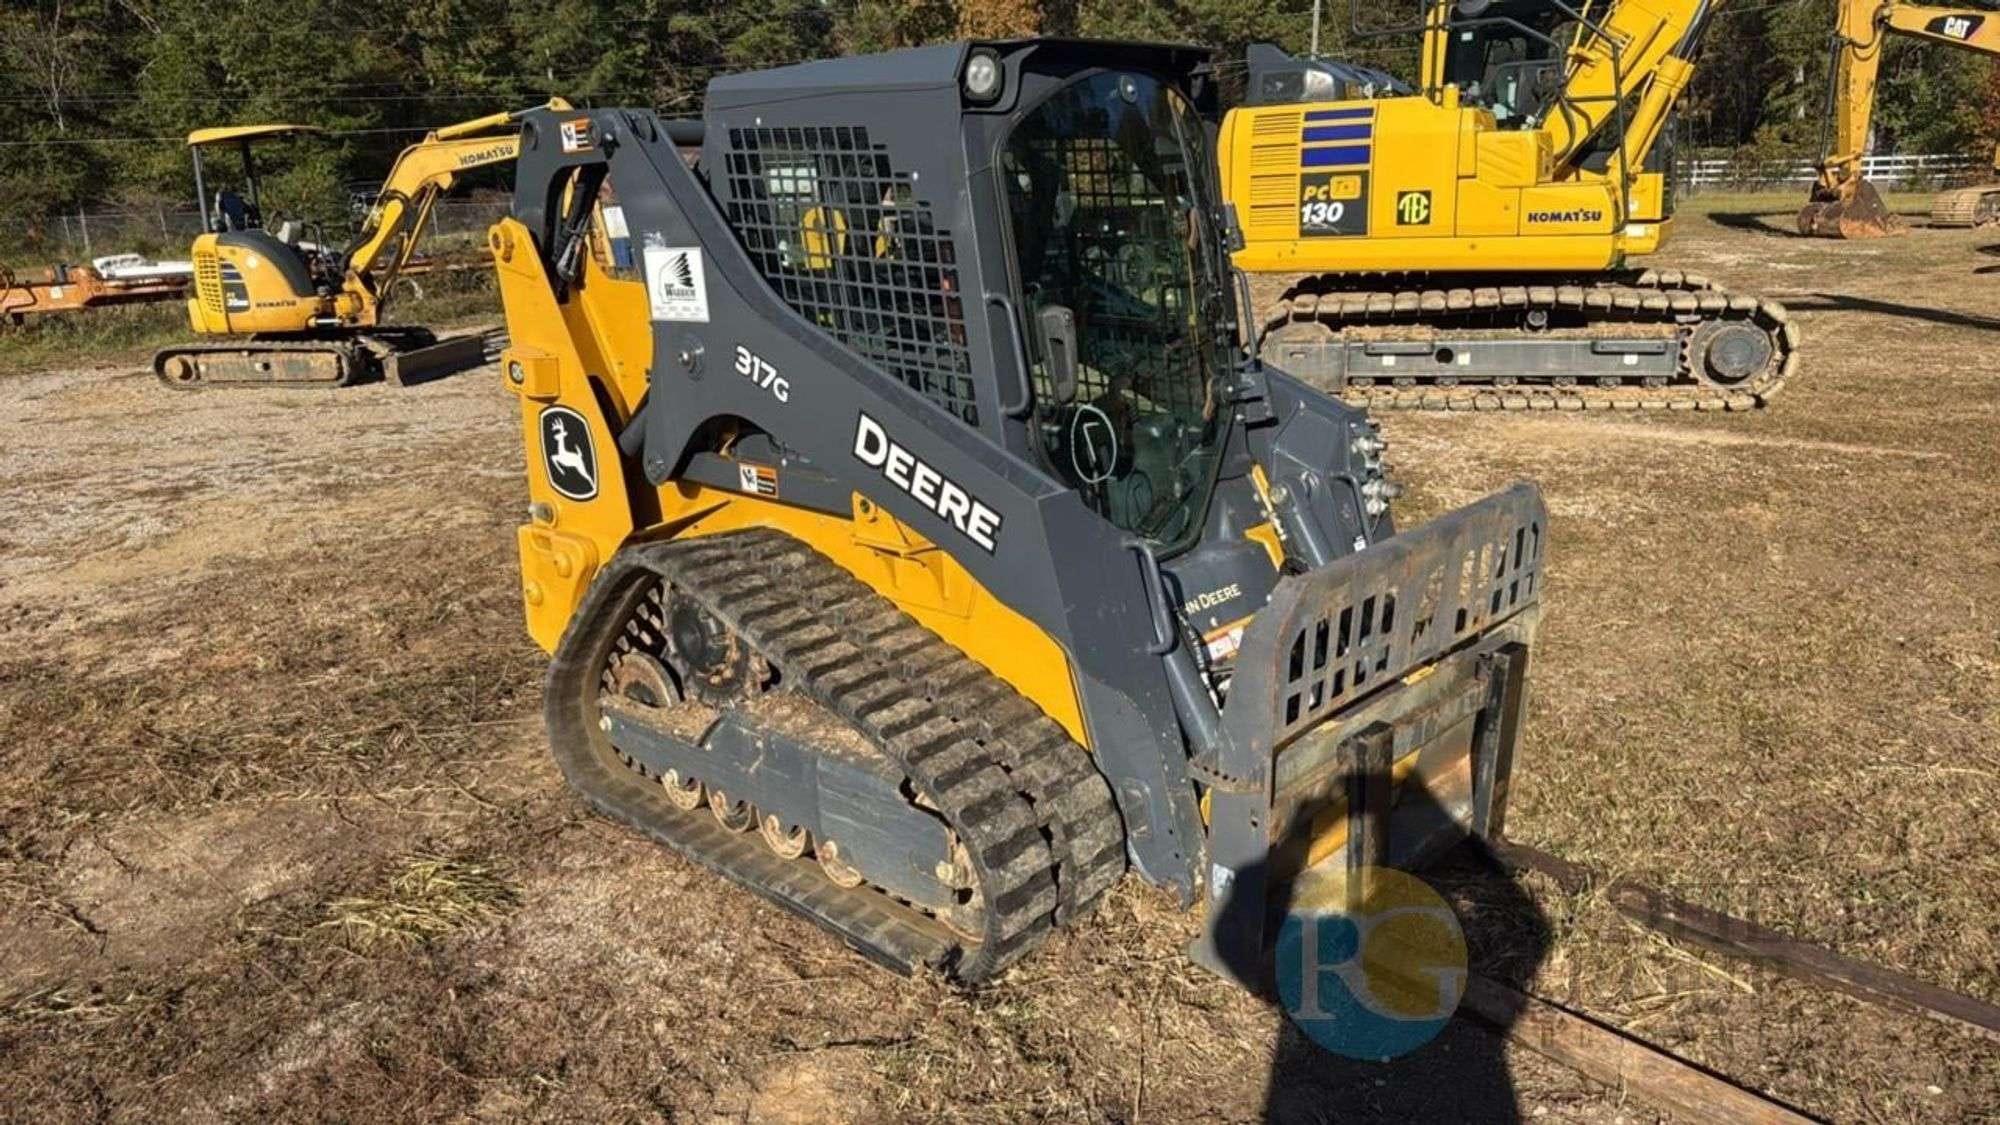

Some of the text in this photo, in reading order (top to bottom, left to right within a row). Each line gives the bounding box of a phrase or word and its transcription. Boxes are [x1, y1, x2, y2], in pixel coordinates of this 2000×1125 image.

[1944, 16, 1970, 39] CAT
[459, 145, 515, 166] KOMATSU
[1303, 184, 1330, 202] PC
[1301, 202, 1344, 223] 130
[1527, 208, 1602, 223] KOMATSU
[735, 346, 790, 402] 317G
[854, 411, 1001, 552] DEERE
[1198, 583, 1242, 608] DEERE
